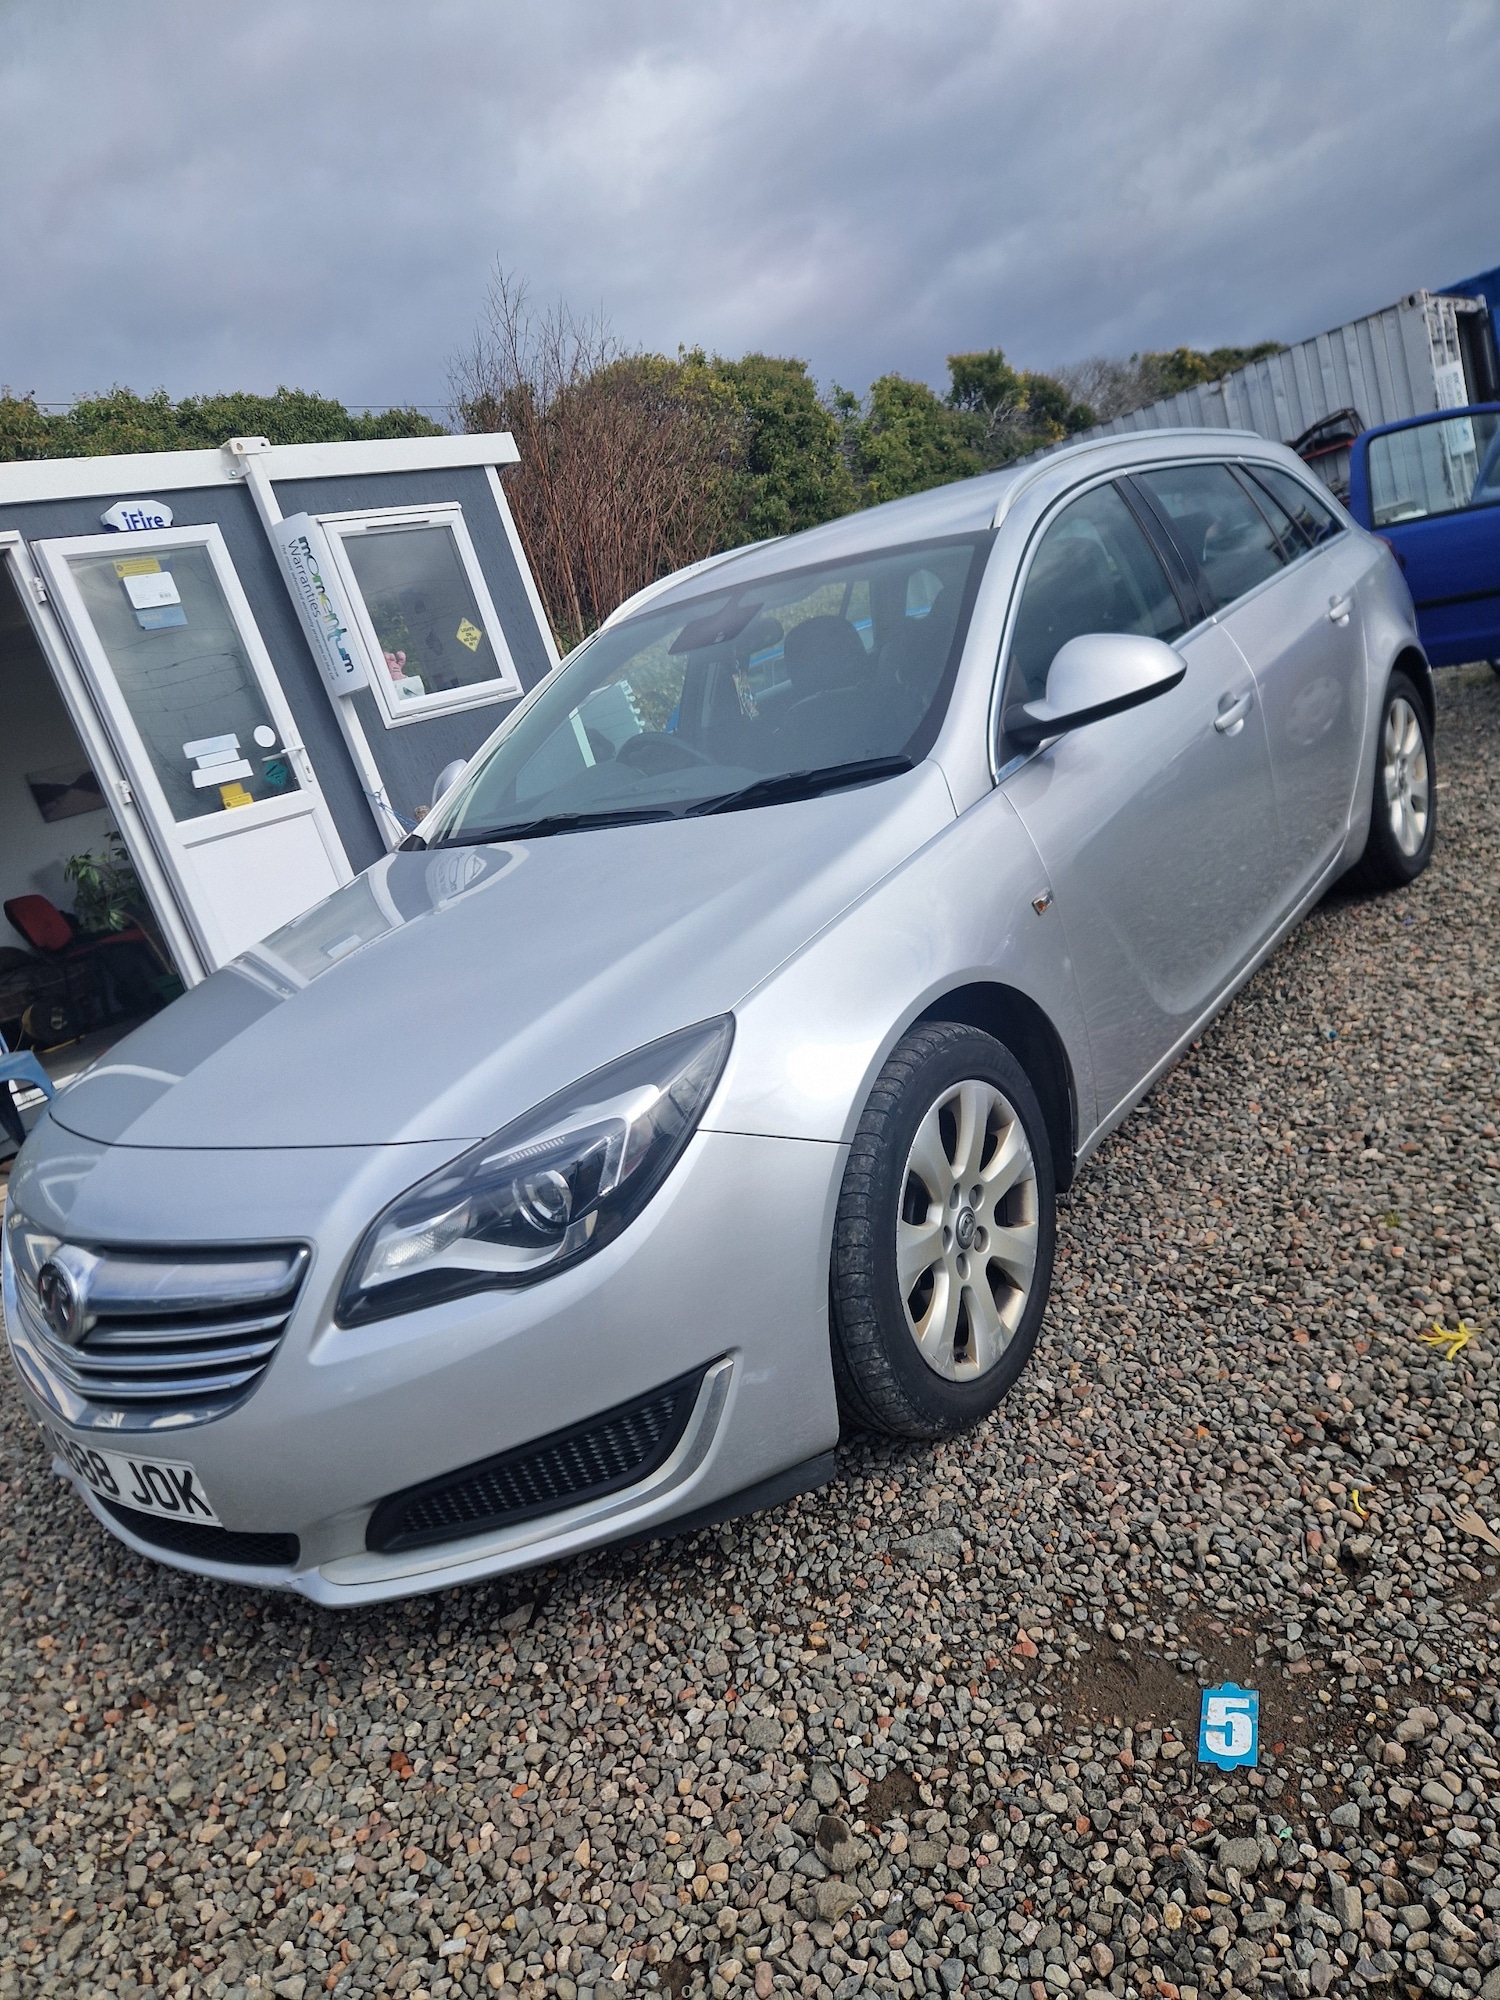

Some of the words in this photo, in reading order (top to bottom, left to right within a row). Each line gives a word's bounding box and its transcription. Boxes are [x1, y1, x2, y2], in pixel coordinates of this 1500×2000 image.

[121, 508, 164, 530] iFire
[287, 539, 322, 618] Warranties
[298, 535, 354, 673] momentum
[128, 1461, 213, 1516] JOK
[1205, 1697, 1252, 1757] 5
